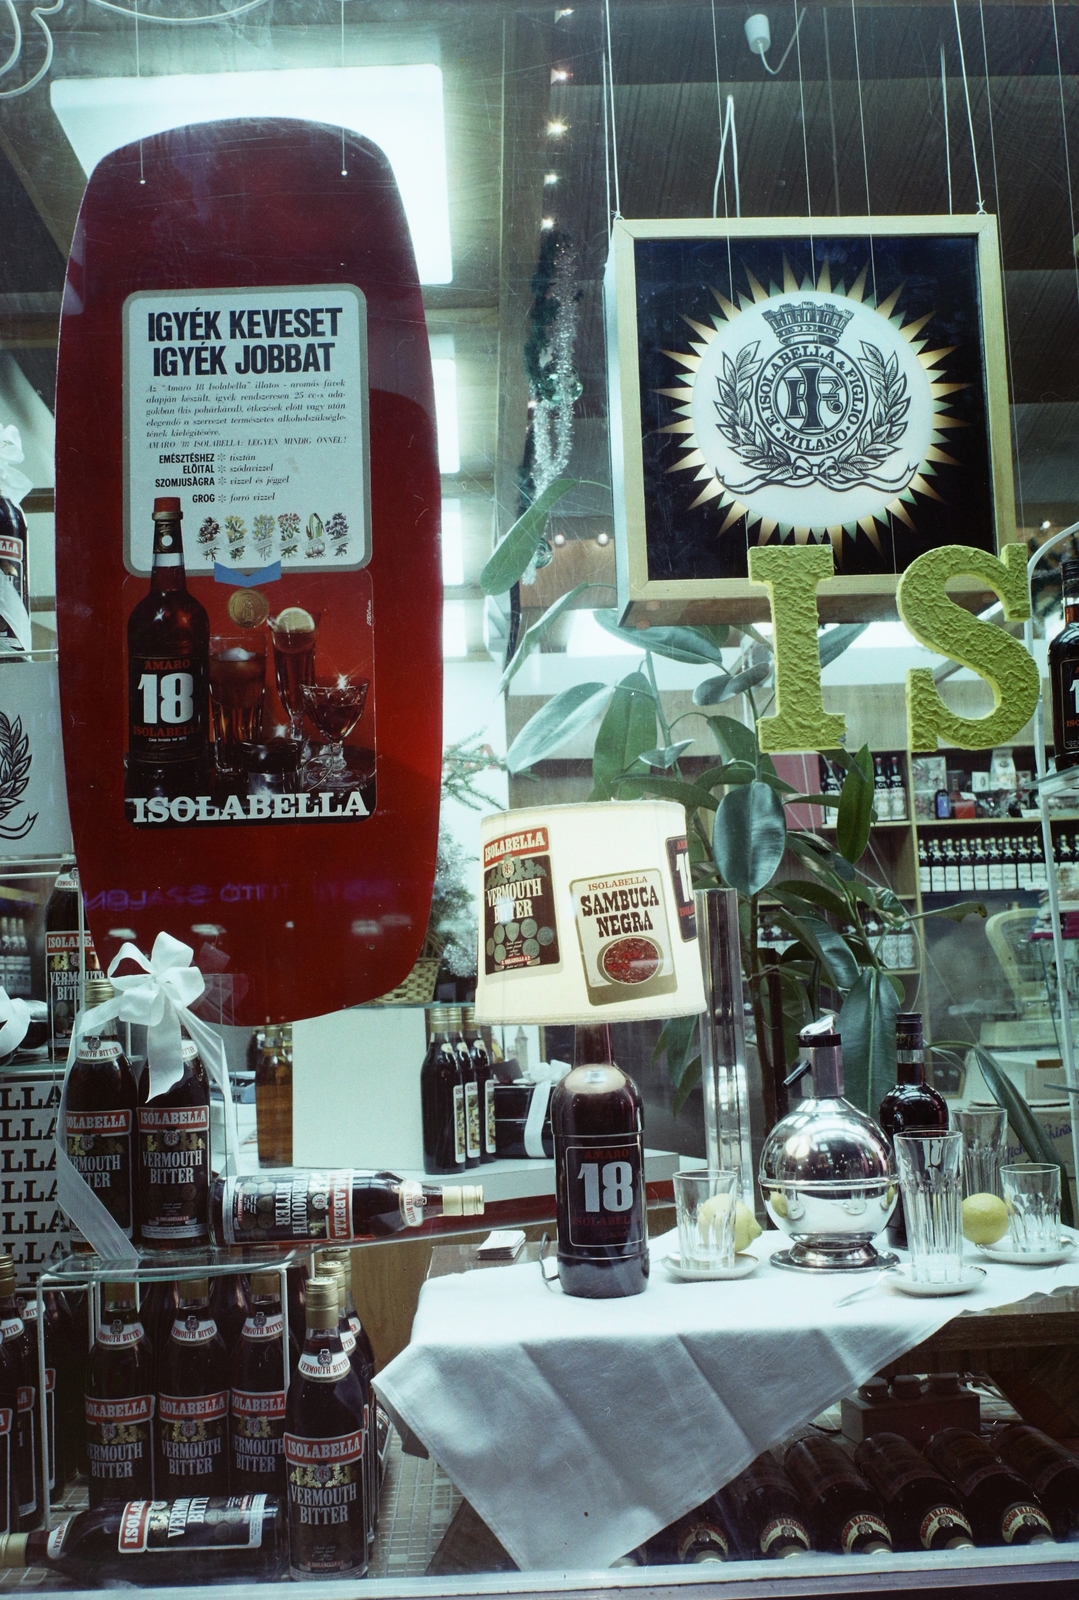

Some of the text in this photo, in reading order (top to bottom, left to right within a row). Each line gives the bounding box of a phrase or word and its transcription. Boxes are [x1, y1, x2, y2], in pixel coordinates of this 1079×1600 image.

[148, 307, 343, 342] IGYÉK KEVESET
[153, 342, 336, 377] IGYÉK JOBBAT
[254, 381, 280, 390] illatos
[290, 379, 320, 389] aromás
[836, 361, 846, 373] &
[844, 367, 865, 426] FIGLIO
[146, 395, 177, 405] alapján
[241, 392, 290, 401] rendszeresen
[294, 391, 304, 400] 25
[146, 406, 175, 417] gokban
[246, 403, 283, 413] étkezések
[328, 402, 346, 411] után
[193, 418, 227, 426] szervezet
[230, 415, 275, 425] természetes
[146, 429, 168, 438] tének
[147, 440, 176, 449] AMARO
[248, 438, 279, 447] LEGYEN
[284, 437, 312, 446] MINDIG
[780, 429, 849, 452] MILANO
[159, 452, 257, 464] EMÉSZTÉSHEZ tisztán
[266, 475, 290, 486] jéggel
[193, 494, 216, 504] GROG
[230, 494, 251, 504] forró
[144, 660, 192, 671] AMARO
[137, 672, 194, 724] 18
[133, 791, 370, 823] ISOLABELLA
[485, 832, 546, 861] ISOLABELLA
[487, 878, 543, 907] VERMOUTH
[588, 876, 648, 891] ISOLABELLA
[580, 885, 660, 917] SAMBUCA
[596, 910, 653, 938] NEGRA
[141, 1110, 207, 1126] ISOLABELLA
[143, 1150, 203, 1169] VERMOUTH
[584, 1149, 629, 1160] AMARO
[151, 1168, 194, 1185] BITTER
[577, 1161, 634, 1213] 18
[275, 1181, 292, 1227] BITTER
[161, 1437, 222, 1459] VERMOUTH
[287, 1436, 360, 1458] ISOLABELLA
[91, 1462, 133, 1478] BITTER
[169, 1458, 213, 1476] BITTER
[236, 1452, 276, 1473] BITTER
[291, 1482, 357, 1507] VERMOUTH
[299, 1505, 349, 1525] BITTER
